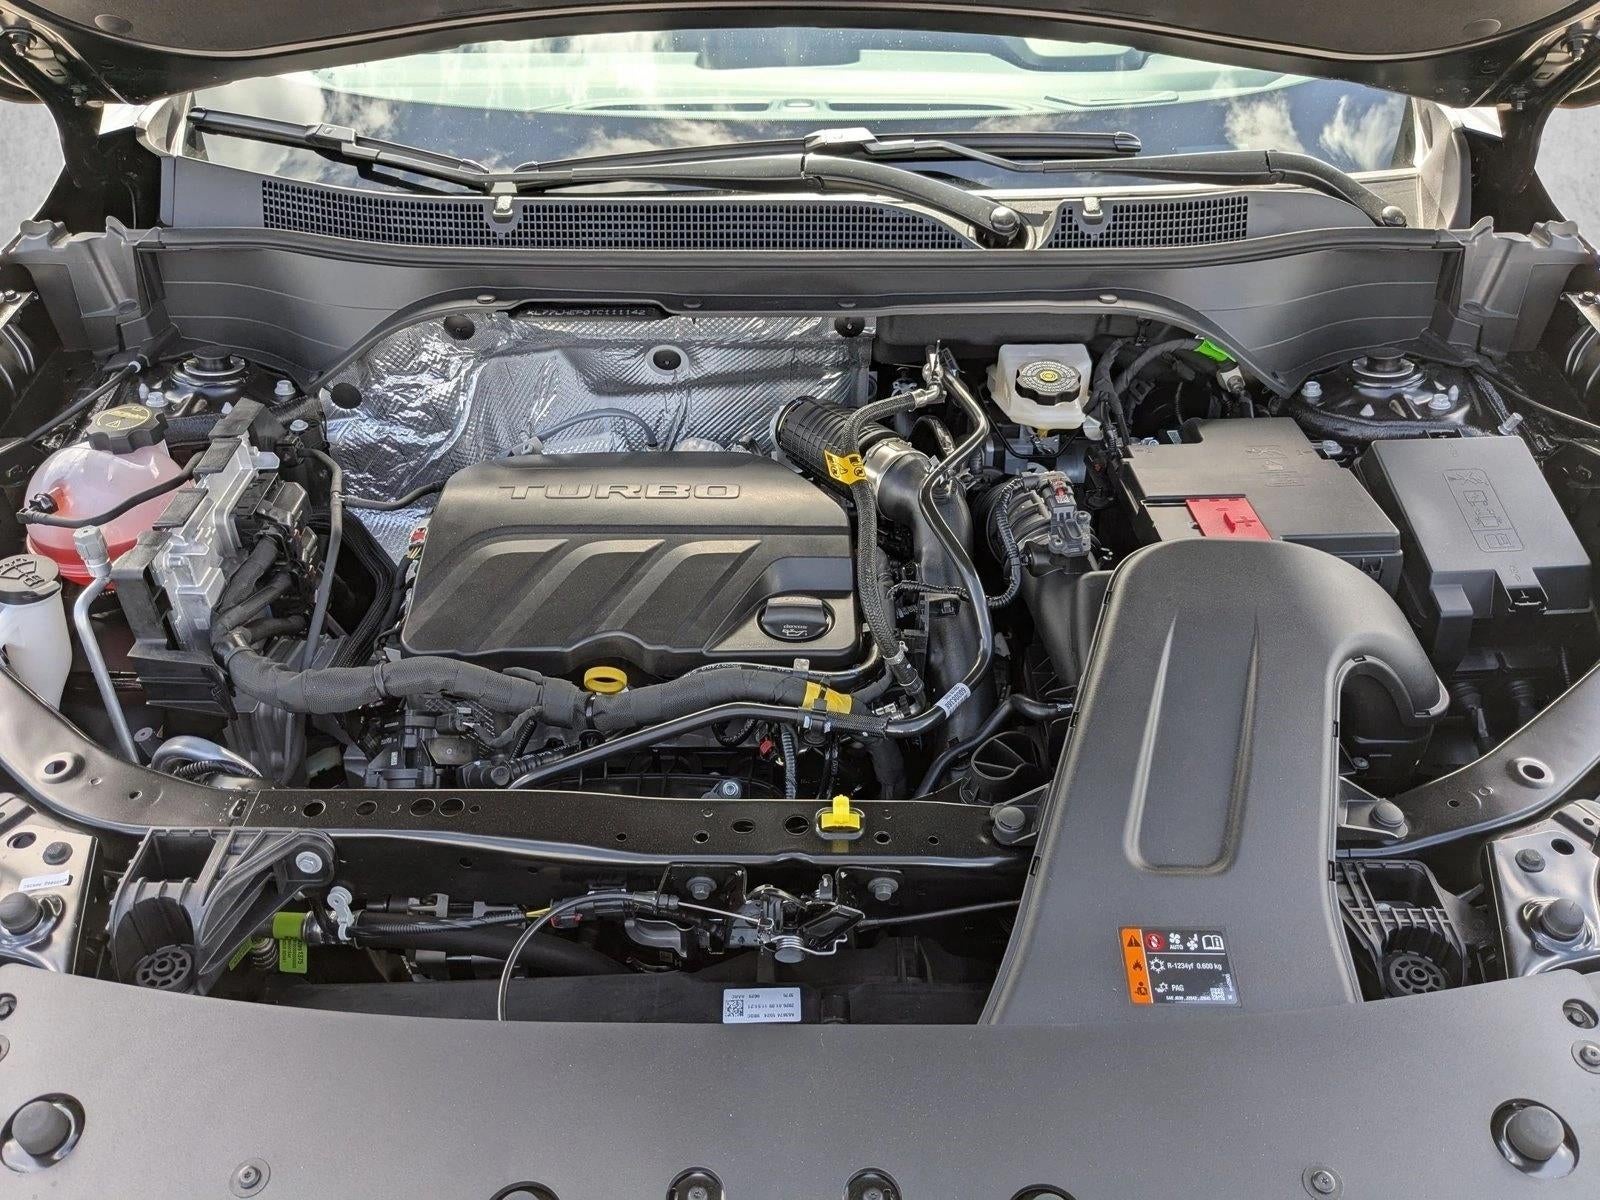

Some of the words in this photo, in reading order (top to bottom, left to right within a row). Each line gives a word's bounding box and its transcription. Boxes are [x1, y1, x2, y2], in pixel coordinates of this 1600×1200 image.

[499, 484, 740, 500] TURBO
[1167, 962, 1194, 970] R-1234yf
[1214, 963, 1223, 971] kg
[1171, 984, 1185, 992] PAG
